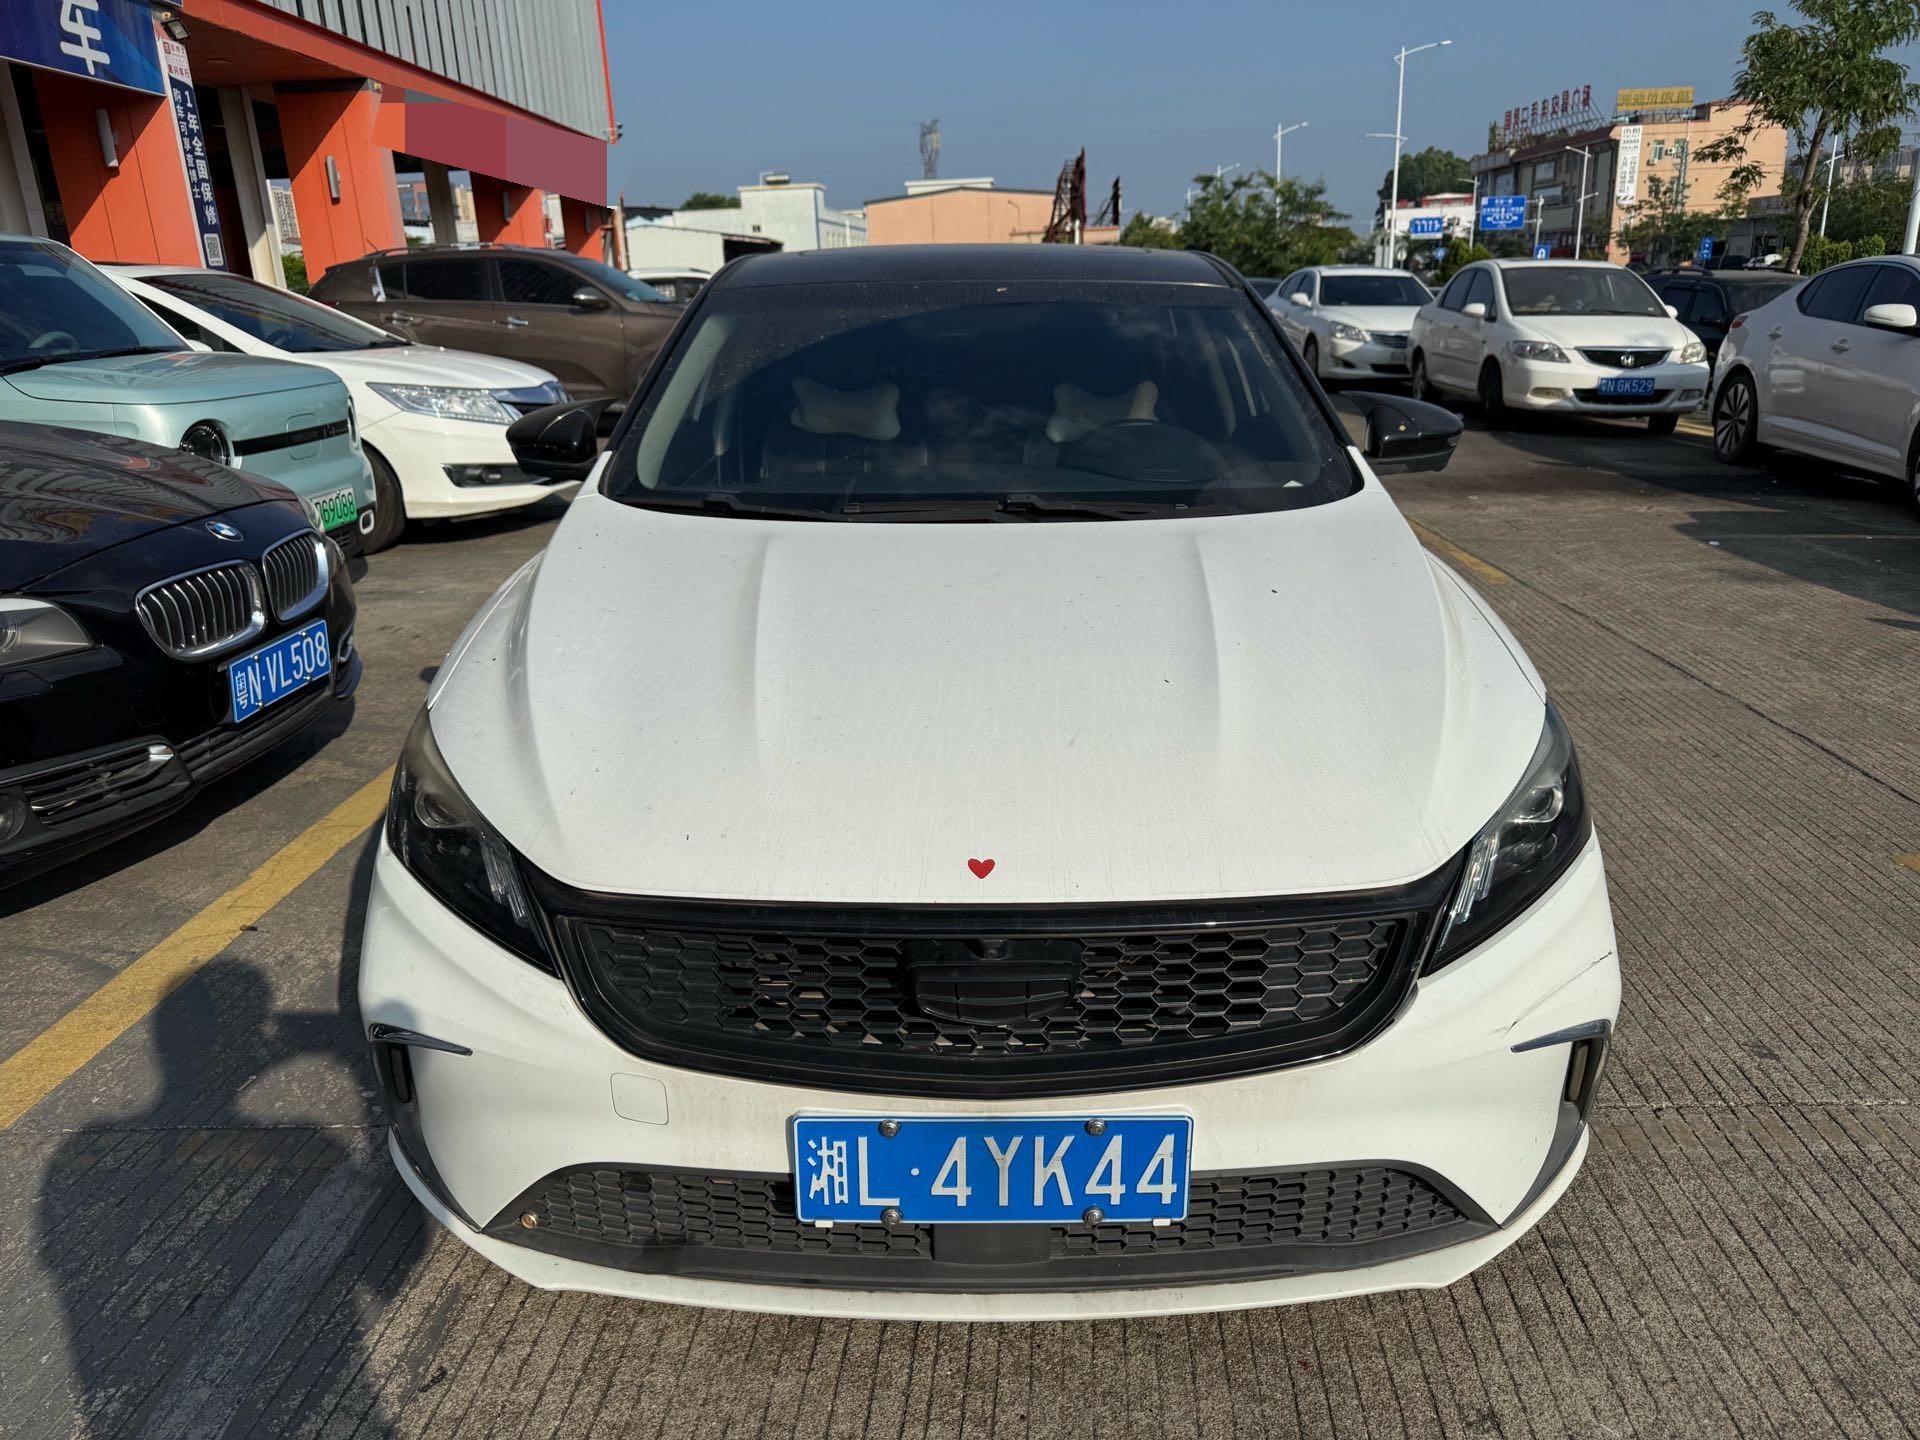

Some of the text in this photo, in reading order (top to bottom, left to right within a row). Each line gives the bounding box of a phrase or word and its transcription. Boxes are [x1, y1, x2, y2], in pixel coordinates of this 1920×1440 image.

[60, 0, 110, 76] 车
[184, 90, 217, 226] 1年全国保修
[806, 1133, 1178, 1207] 湘L·4YK44
